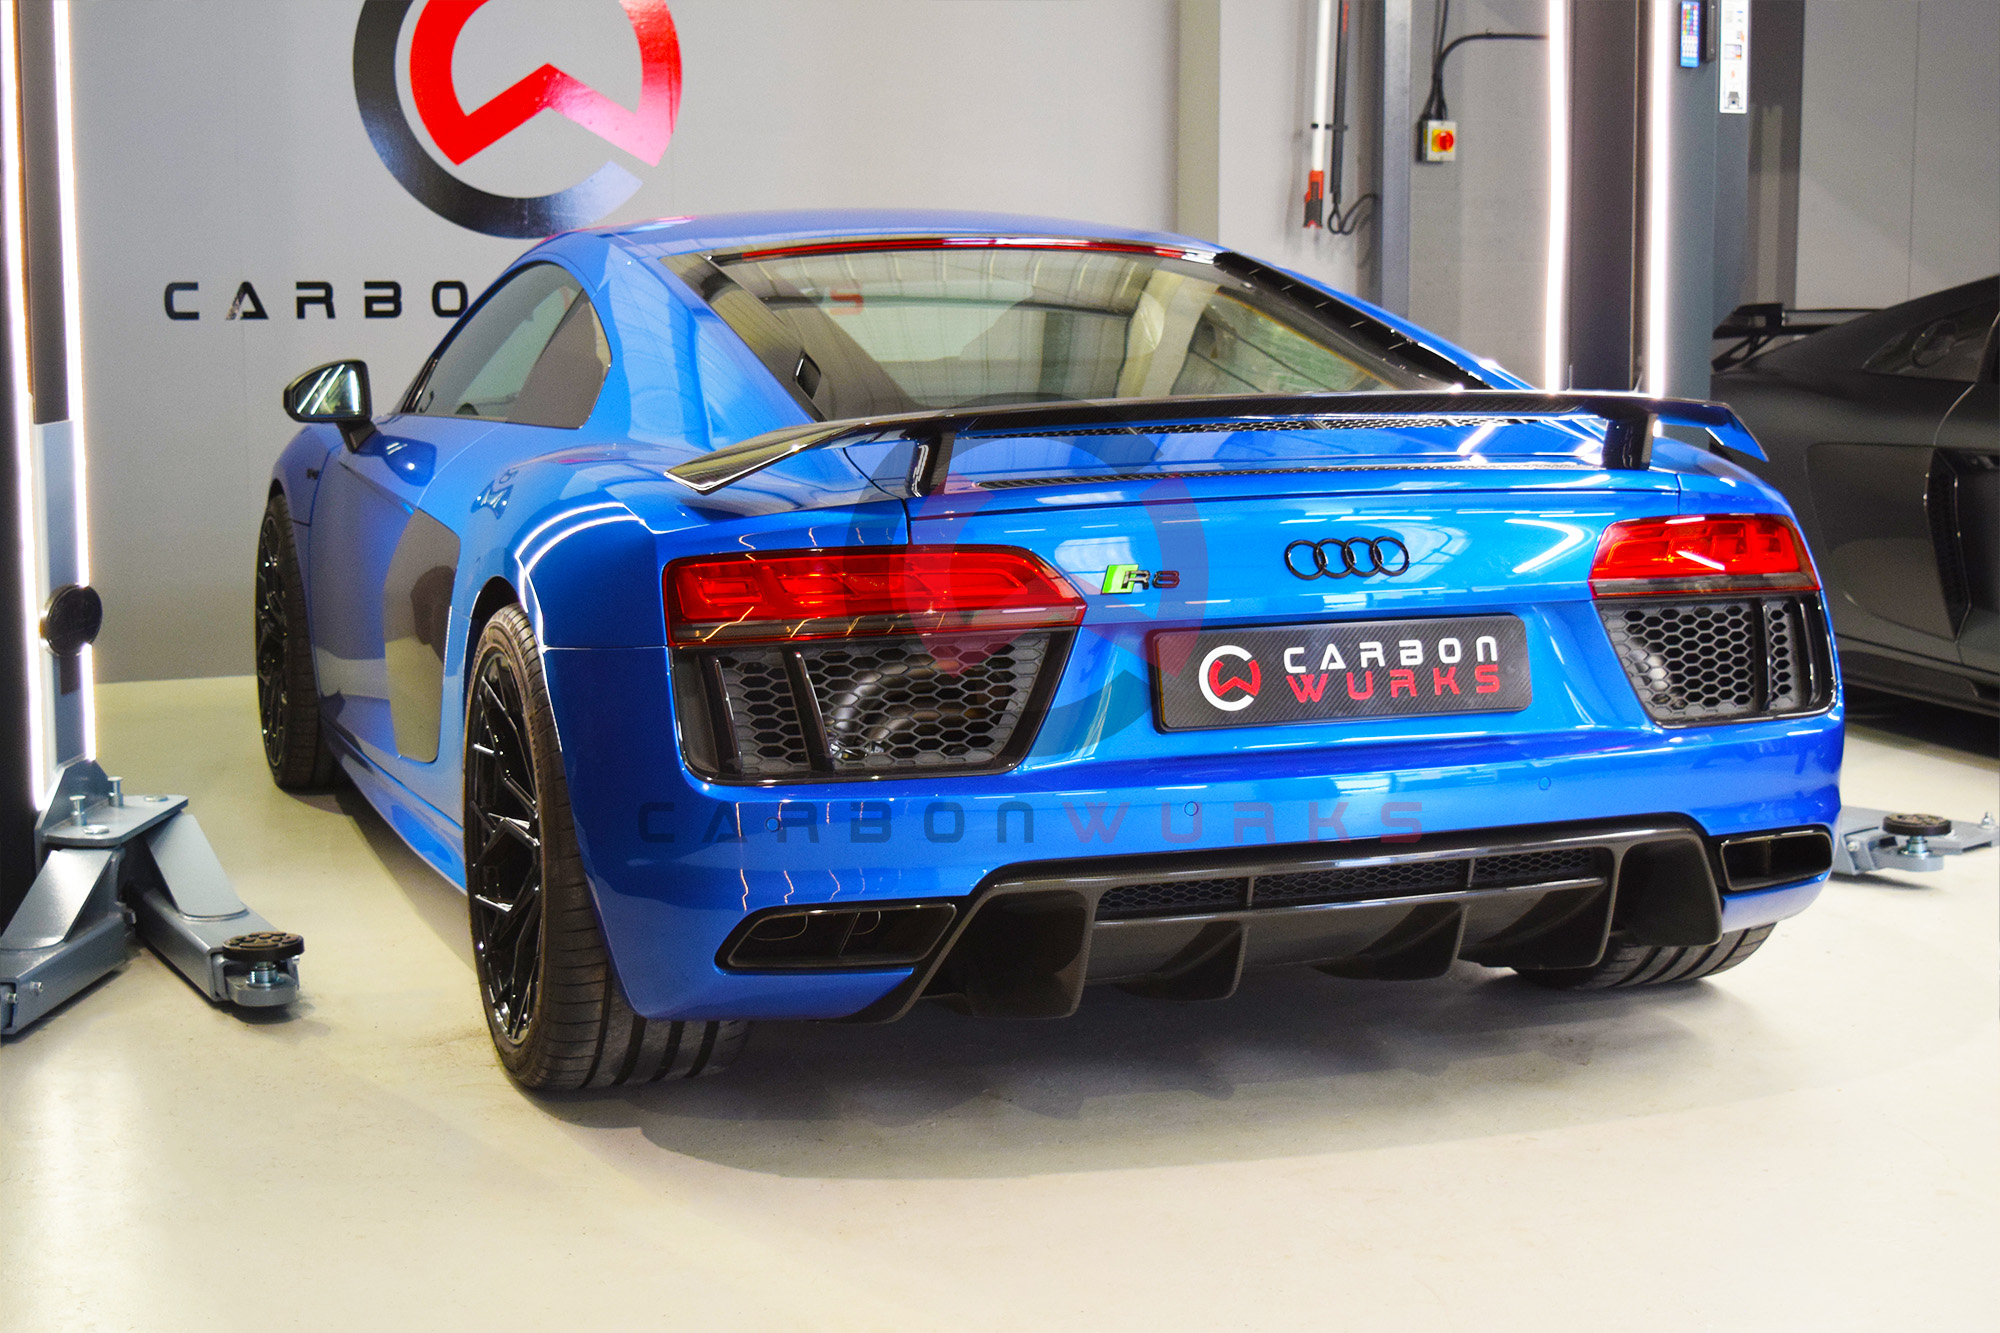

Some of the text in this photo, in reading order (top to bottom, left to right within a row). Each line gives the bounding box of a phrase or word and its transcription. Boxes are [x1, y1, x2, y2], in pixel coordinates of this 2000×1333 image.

[164, 281, 469, 320] CARBO
[1121, 570, 1180, 590] R8
[1283, 635, 1498, 673] CARBON
[1286, 664, 1500, 703] WURKS
